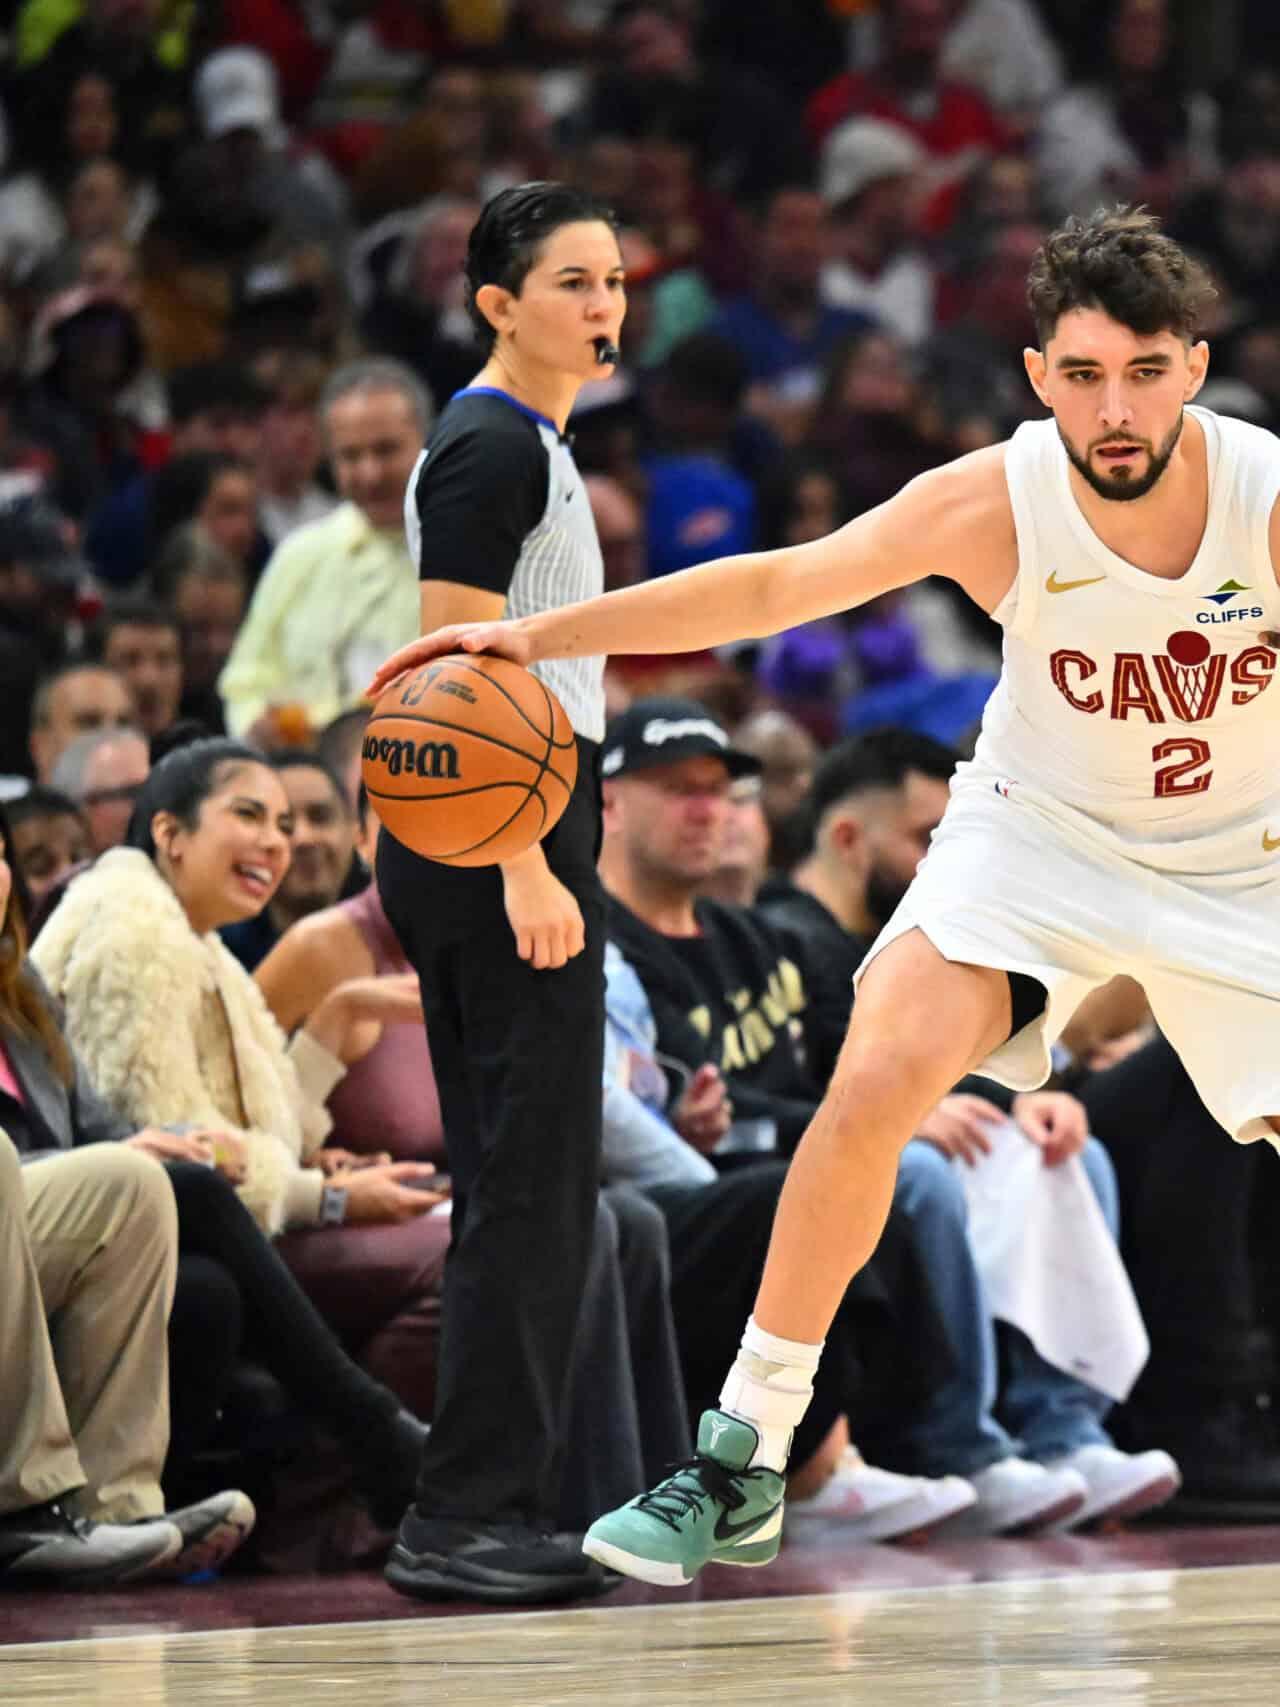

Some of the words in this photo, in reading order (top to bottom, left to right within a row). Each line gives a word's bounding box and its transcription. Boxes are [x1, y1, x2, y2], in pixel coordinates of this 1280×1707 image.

[1195, 606, 1264, 625] CLIFFS
[1049, 644, 1278, 724] CAVS
[1151, 736, 1214, 798] 2
